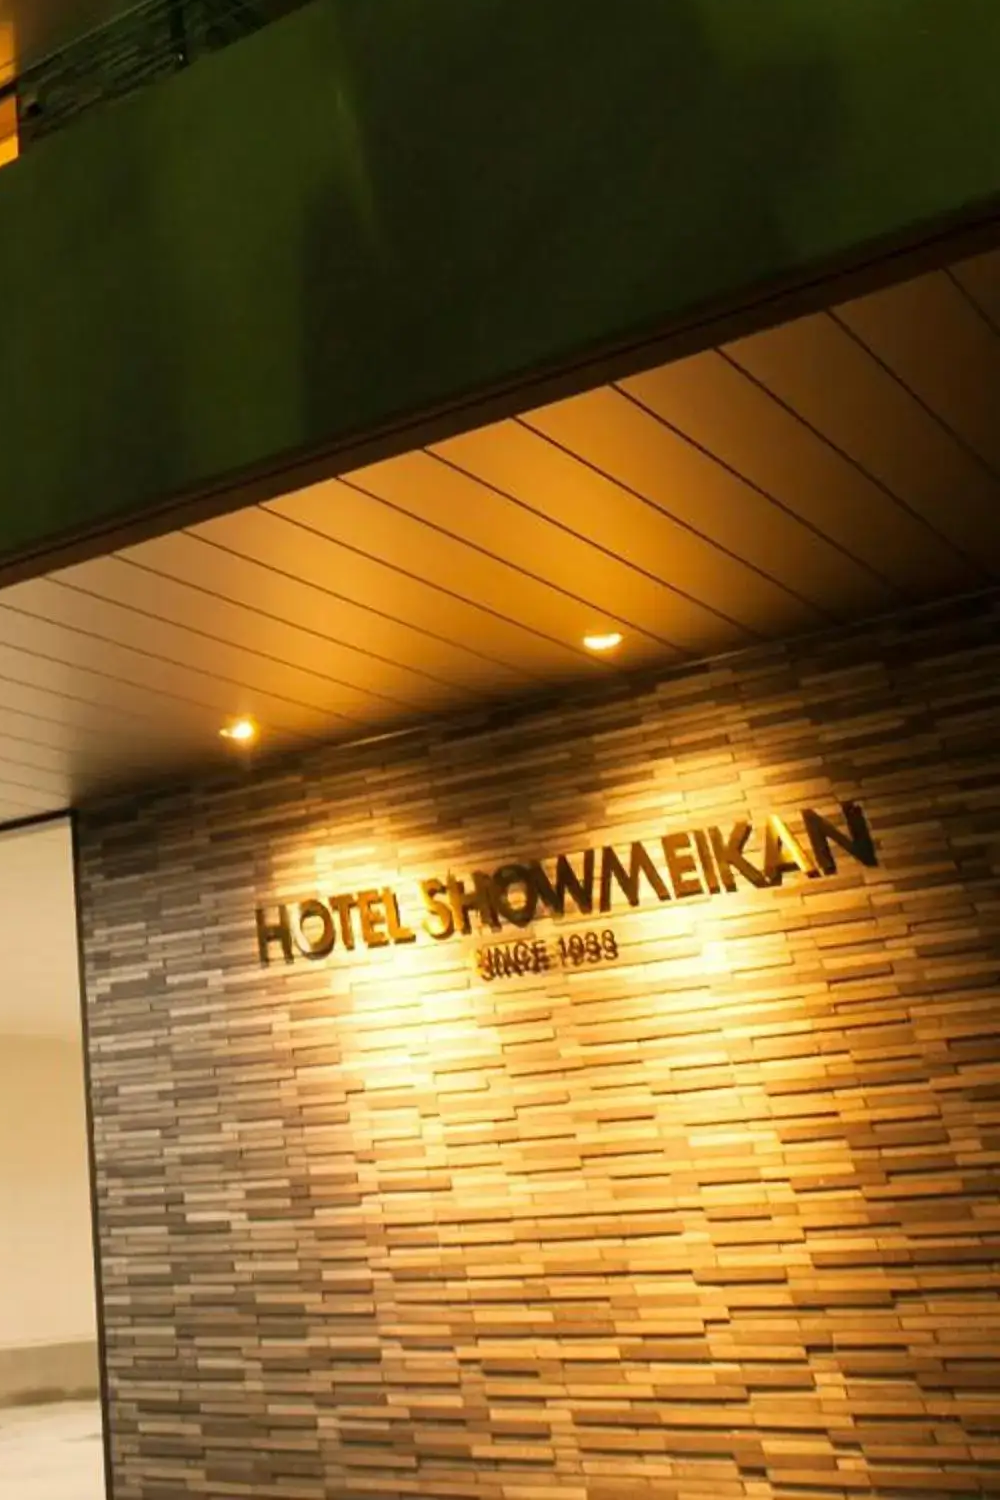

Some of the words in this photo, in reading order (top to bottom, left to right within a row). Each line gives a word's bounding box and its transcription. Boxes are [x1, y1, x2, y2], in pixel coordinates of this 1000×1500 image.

[255, 886, 416, 967] HOTEL
[420, 800, 879, 940] SHOWMEIKAN
[477, 940, 552, 981] SINCE
